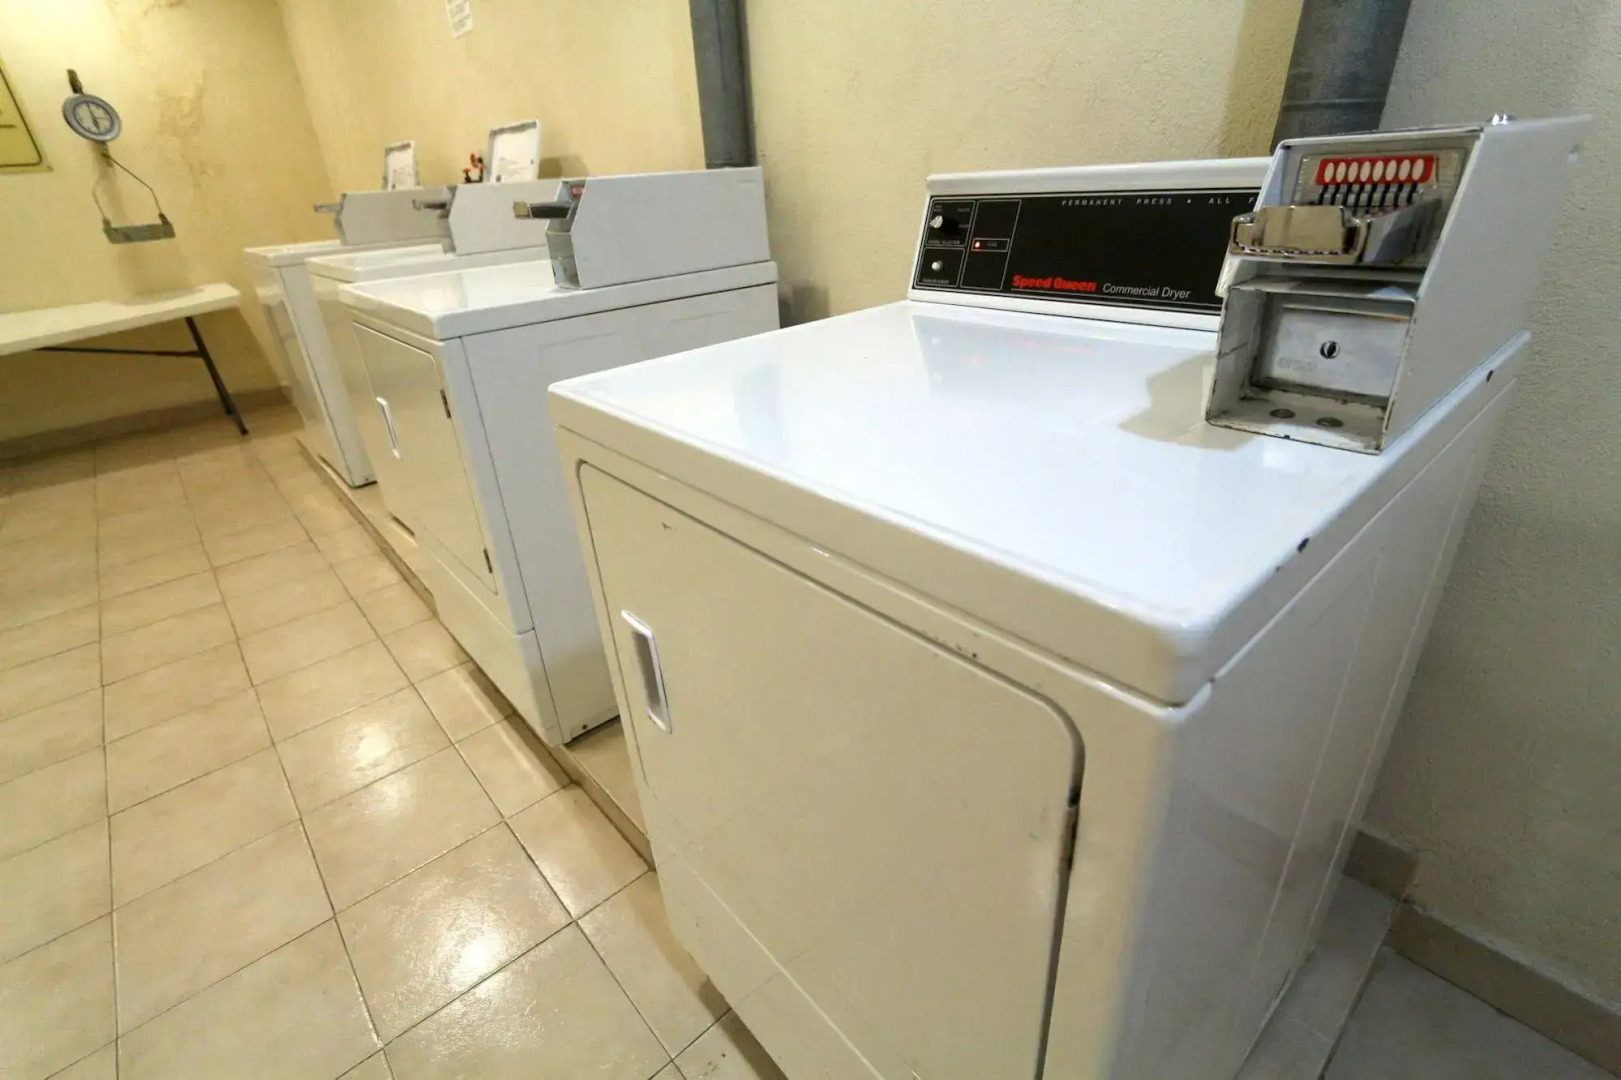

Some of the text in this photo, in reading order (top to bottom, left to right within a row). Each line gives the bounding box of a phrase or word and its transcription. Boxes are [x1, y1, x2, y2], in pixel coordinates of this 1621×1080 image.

[1061, 198, 1122, 206] PERMANENT
[1136, 197, 1173, 205] PRESS
[1208, 196, 1231, 204] ALL
[1012, 274, 1192, 300] Speed Queen Commercial Dryer
